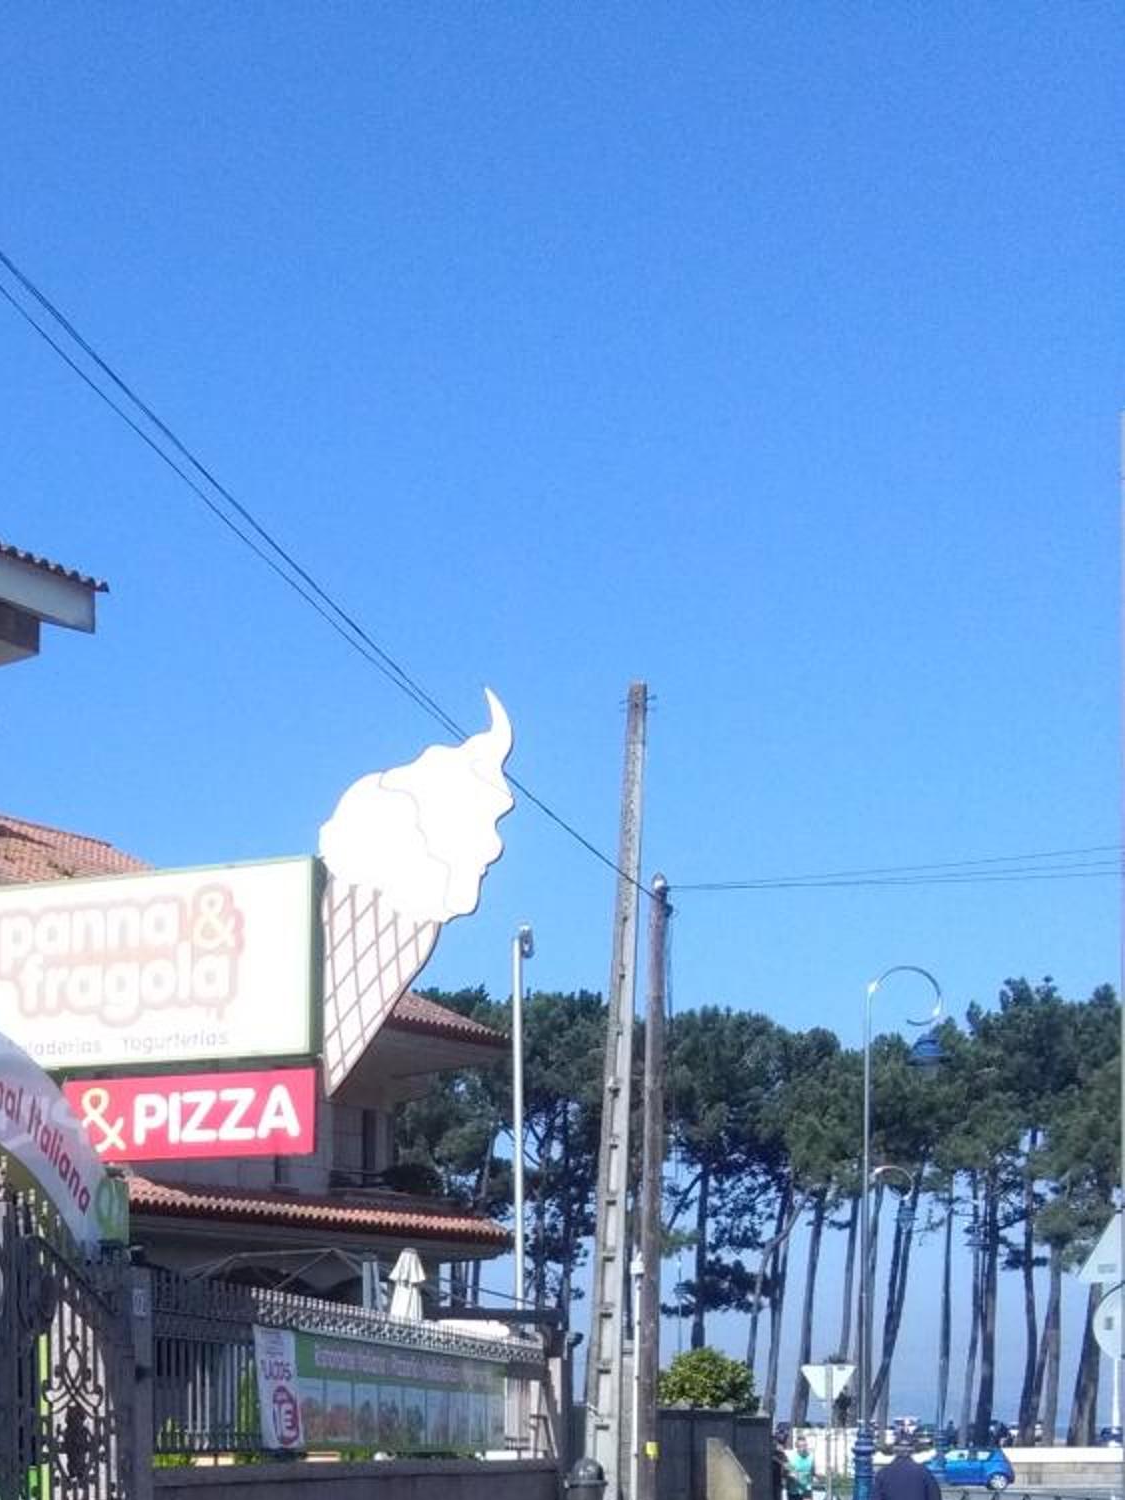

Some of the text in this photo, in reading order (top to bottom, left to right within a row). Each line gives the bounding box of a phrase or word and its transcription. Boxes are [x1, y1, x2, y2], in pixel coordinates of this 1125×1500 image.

[191, 886, 242, 953] &
[19, 941, 233, 1025] fragola
[27, 1095, 92, 1217] Italiana
[81, 1083, 301, 1154] & PIZZA
